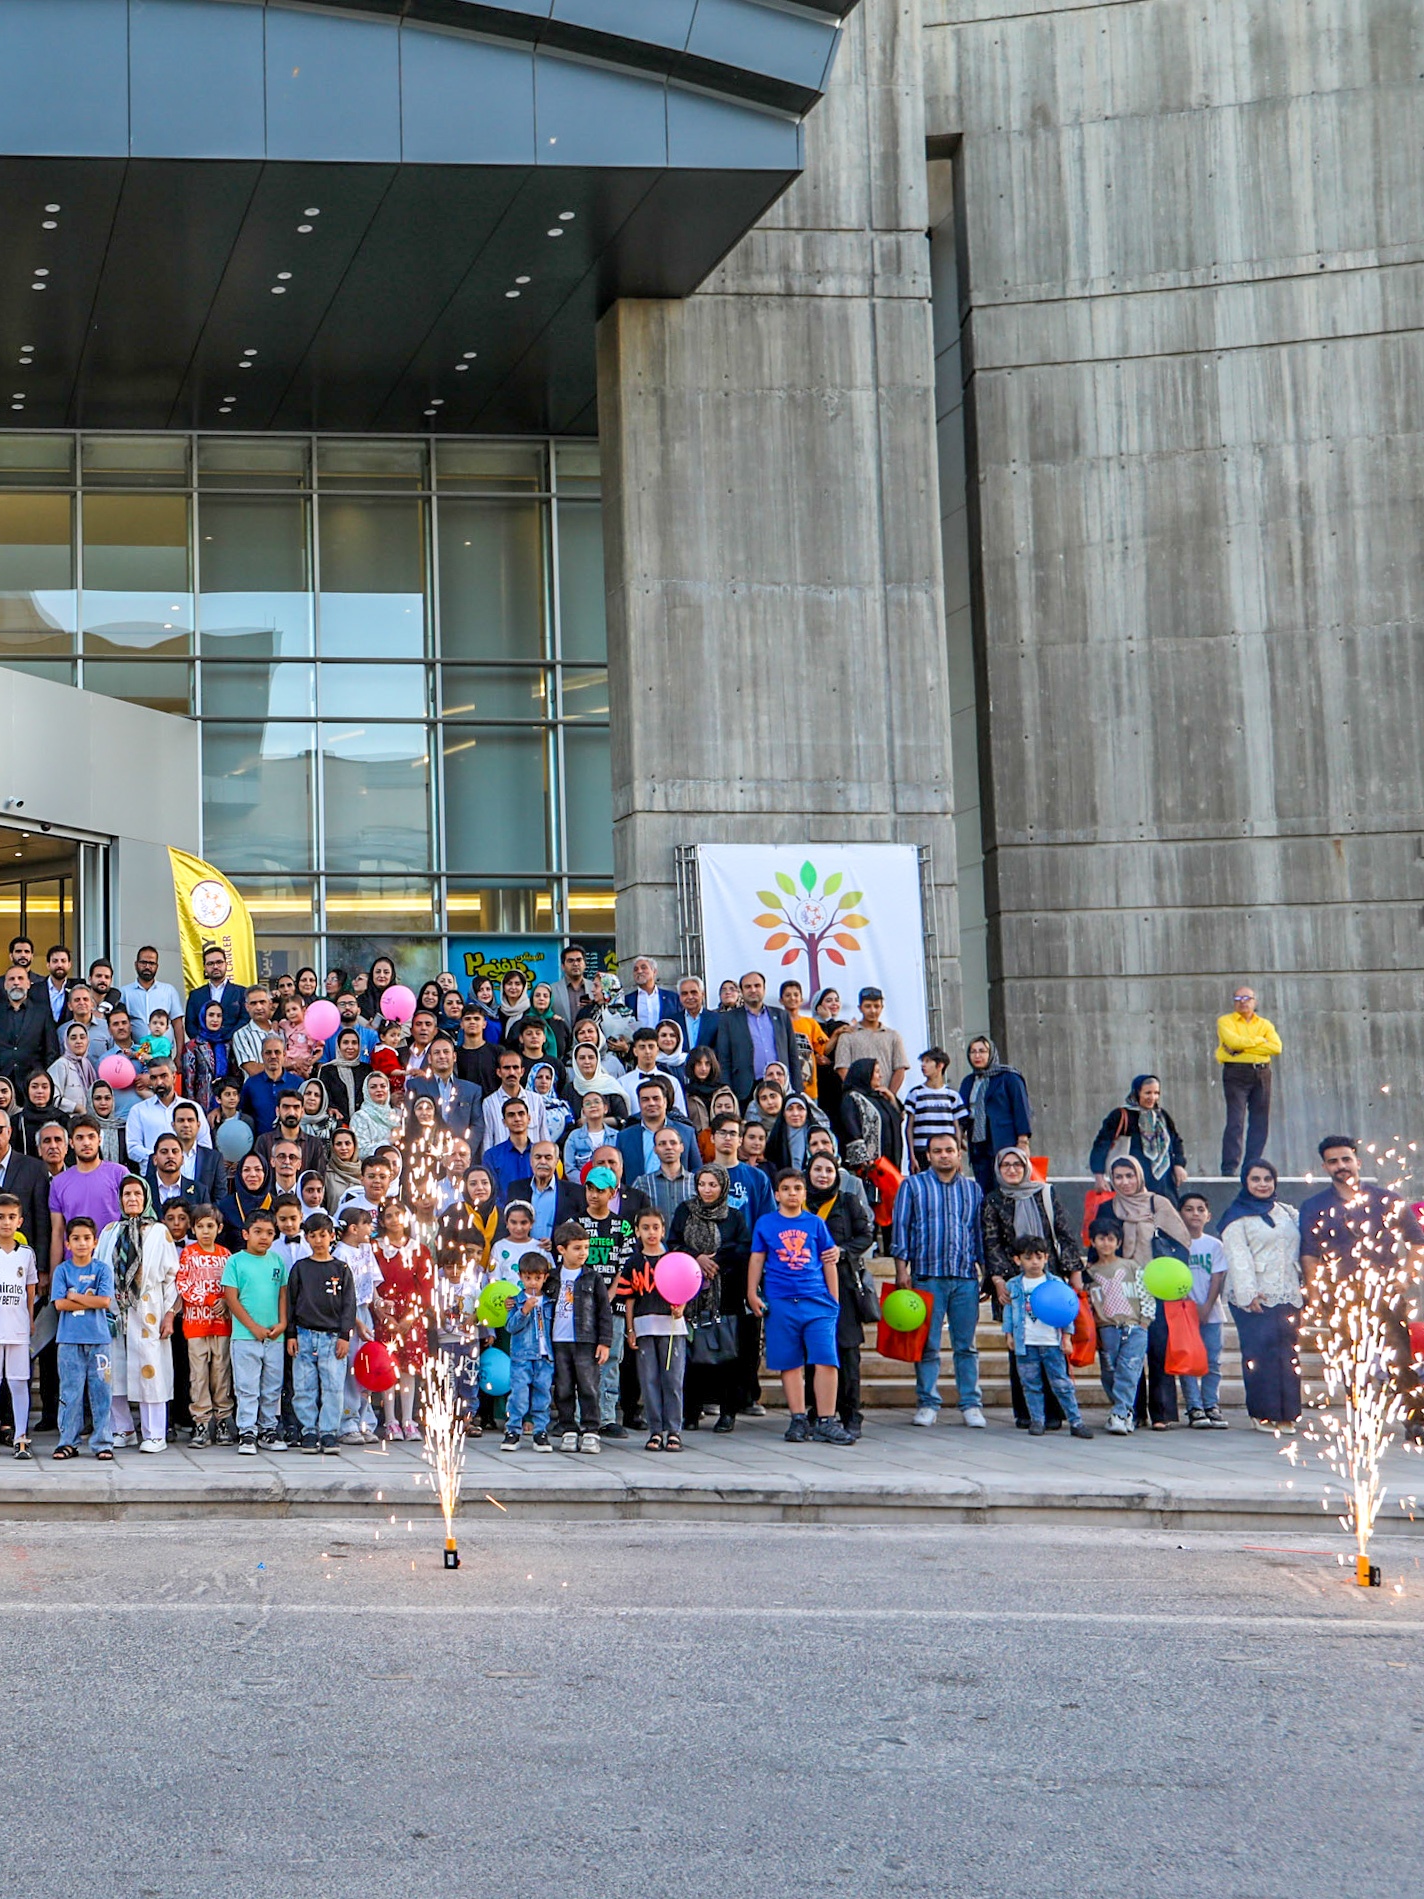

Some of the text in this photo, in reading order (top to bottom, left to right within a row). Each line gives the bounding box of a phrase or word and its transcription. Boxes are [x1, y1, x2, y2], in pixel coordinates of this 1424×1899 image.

[222, 935, 234, 972] CANCER
[586, 1246, 611, 1265] BV
[1, 1295, 20, 1306] BETTER
